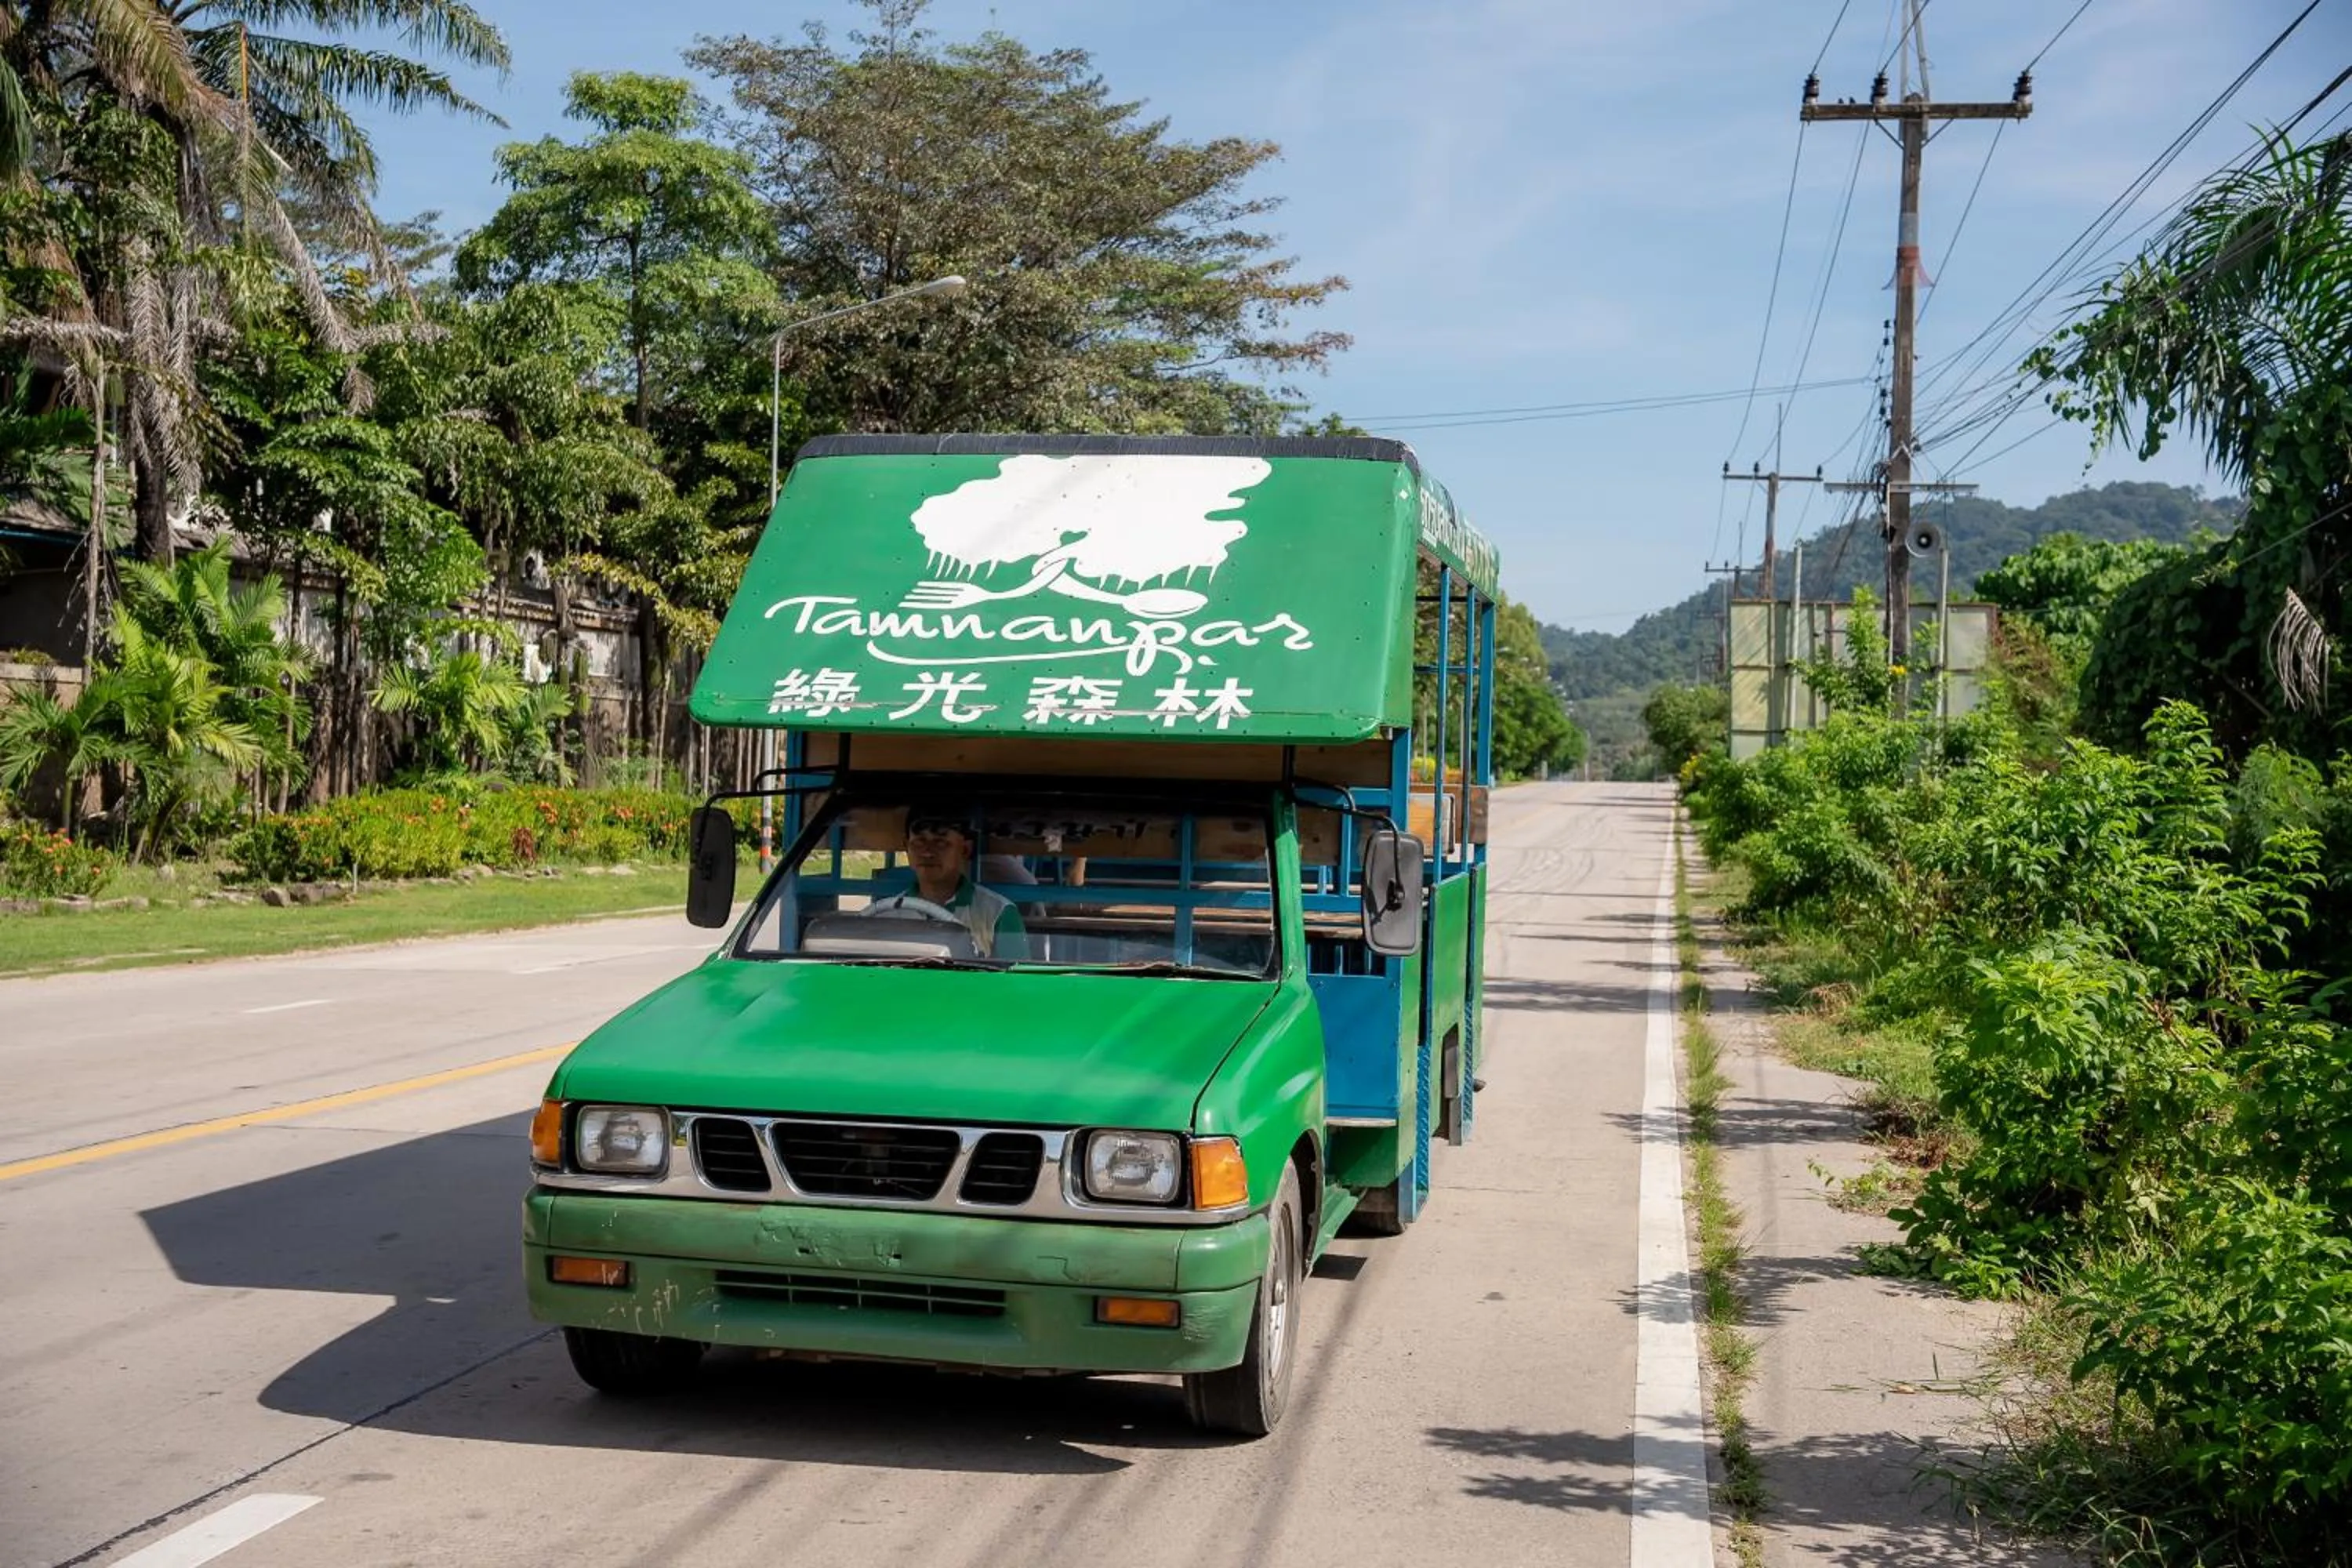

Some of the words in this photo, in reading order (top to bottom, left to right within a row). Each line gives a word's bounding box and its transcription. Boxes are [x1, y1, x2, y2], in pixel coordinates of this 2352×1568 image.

[765, 596, 1313, 676] Tamnanpar
[768, 667, 1253, 729] 綠光森林
